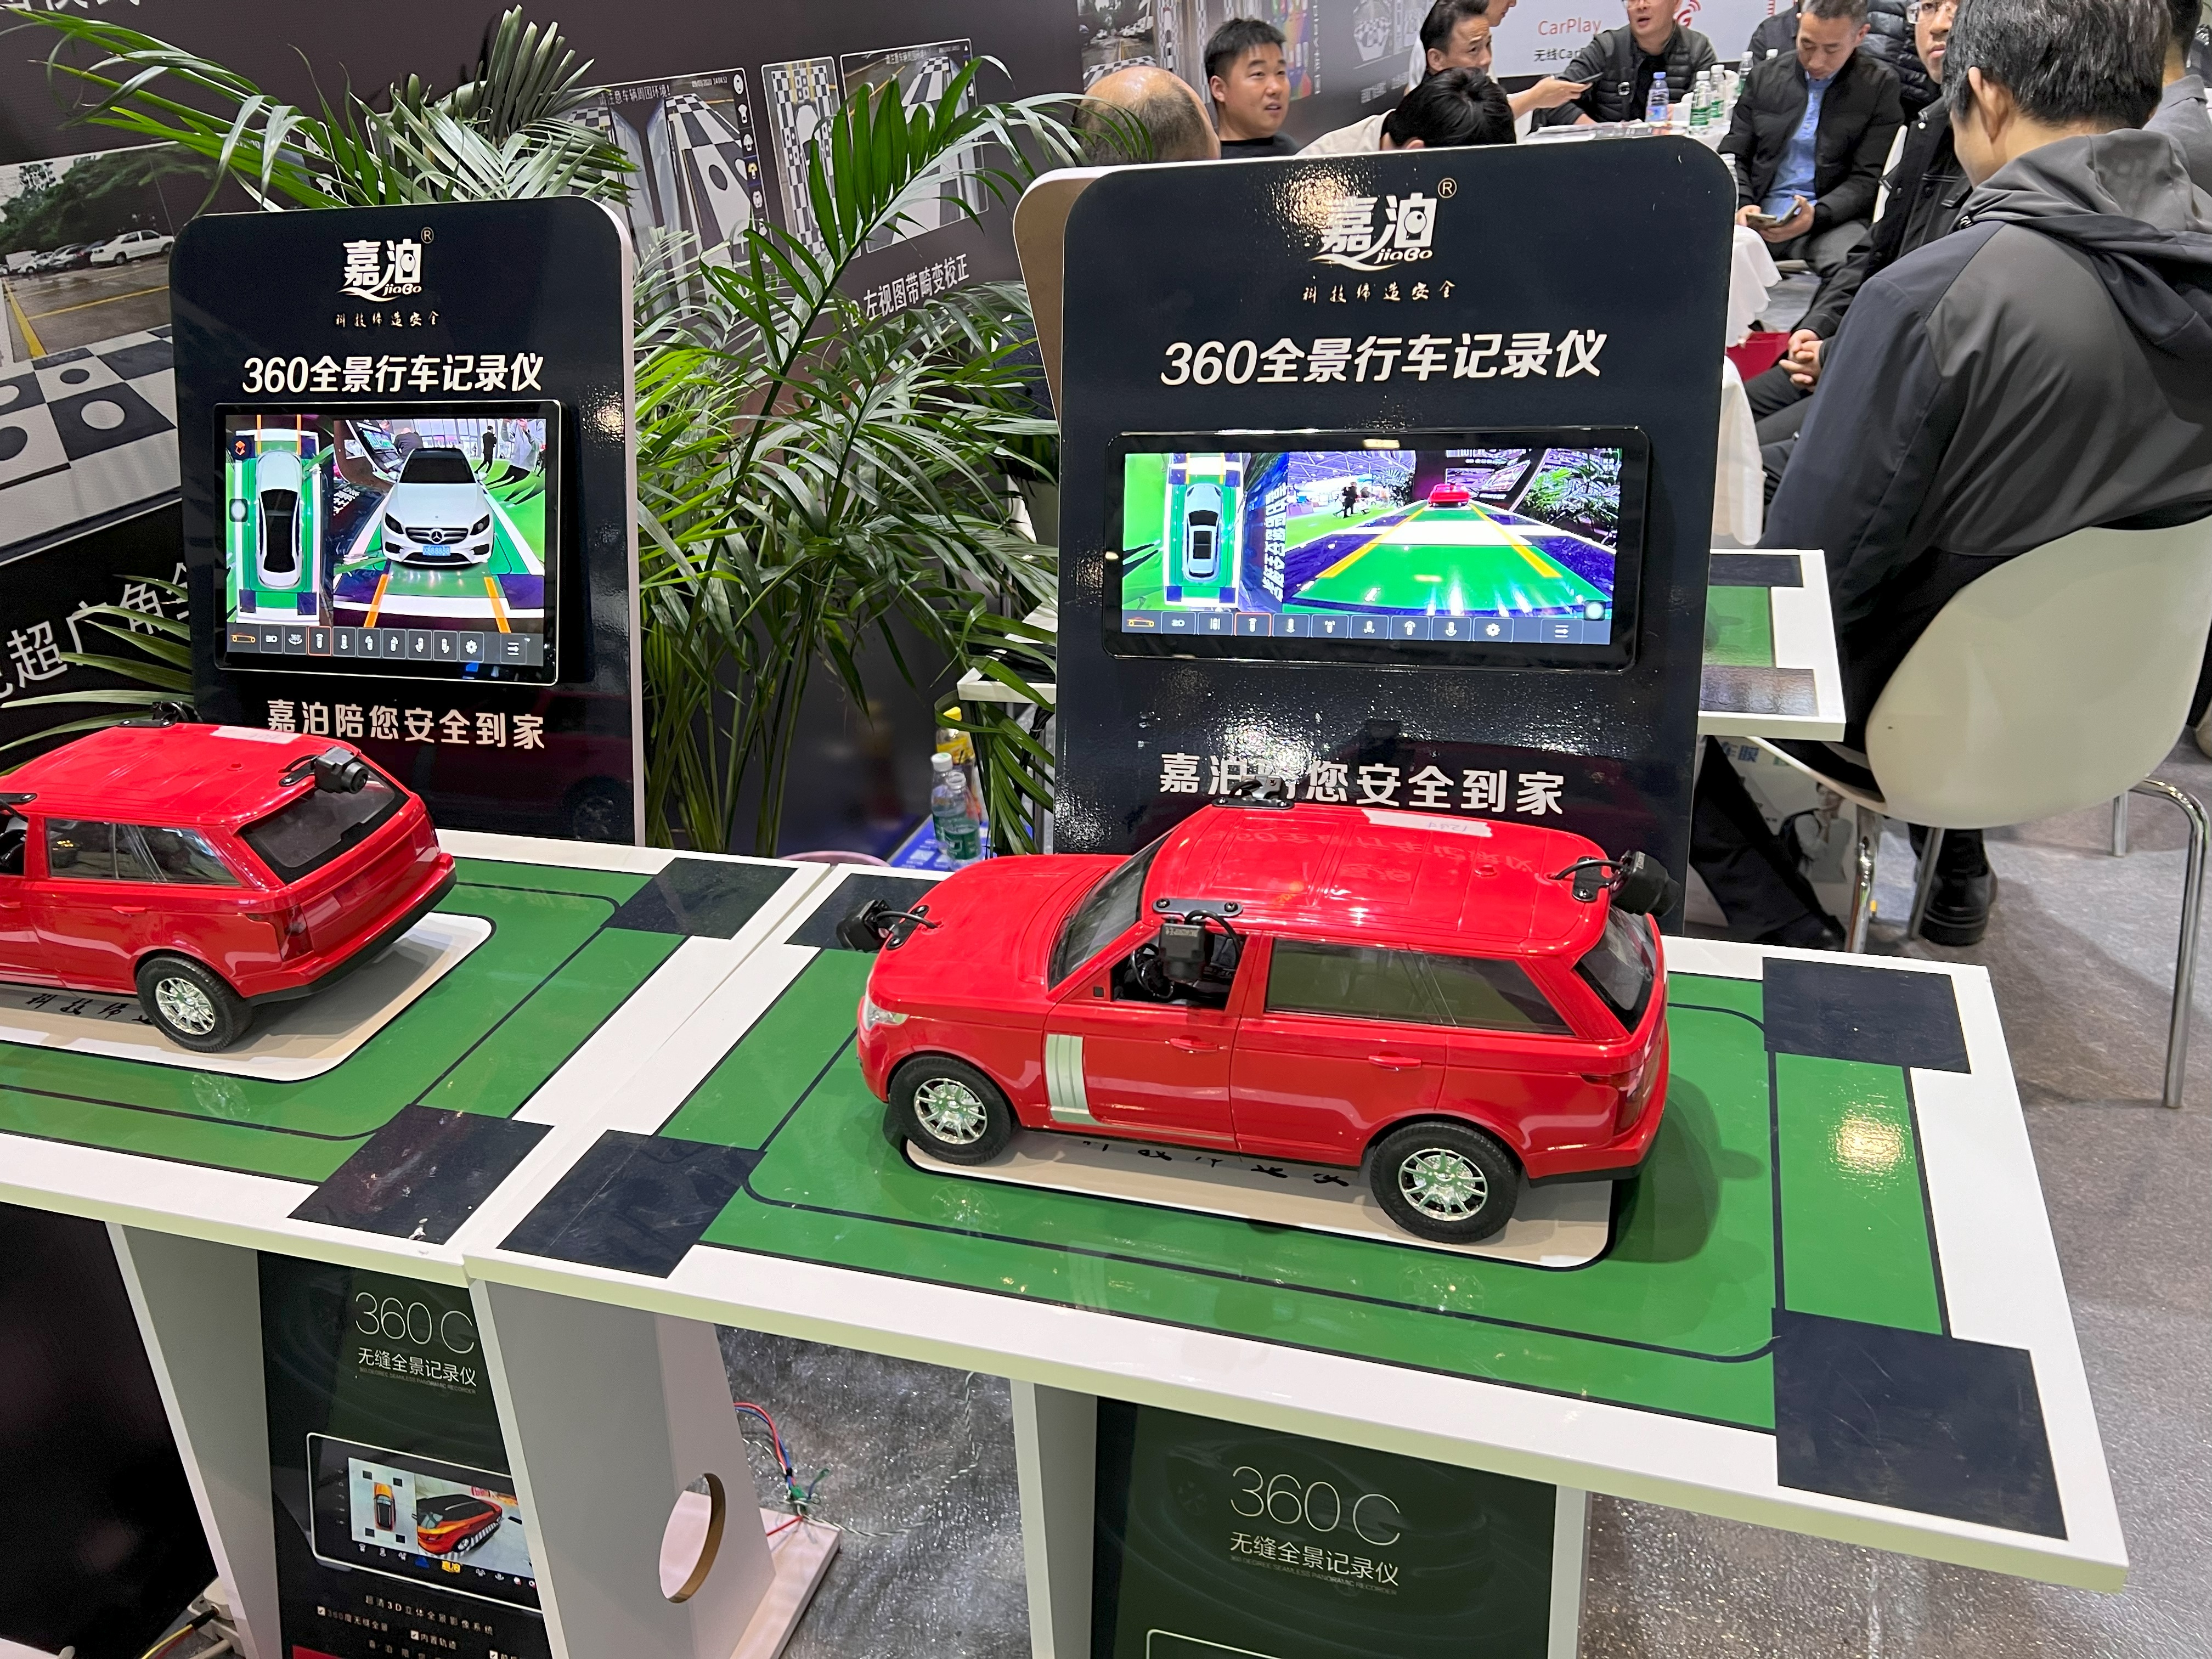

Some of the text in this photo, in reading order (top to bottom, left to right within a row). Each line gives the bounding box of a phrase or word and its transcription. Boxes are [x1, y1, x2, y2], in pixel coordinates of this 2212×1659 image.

[1538, 16, 1601, 36] CarPlay
[1310, 193, 1437, 270] 嘉泊
[338, 239, 421, 300] 嘉泊
[864, 253, 969, 321] 左视图带畸变校正
[242, 353, 544, 393] 360全景行车记录仪
[1161, 329, 1607, 385] 360全景行车记录仪
[268, 699, 544, 750] 嘉泊陪您安全到家
[1160, 752, 1565, 815] 嘉泊您安全到家
[356, 1291, 432, 1345] 360
[358, 1347, 477, 1387] 无缝全景记录仪
[1231, 1466, 1341, 1532] 360
[1231, 1531, 1398, 1586] 无缝全景记录仪
[1273, 1564, 1311, 1577] SEAMLESS
[1311, 1572, 1354, 1587] PANORAMIC
[1356, 1581, 1397, 1595] RECORDER
